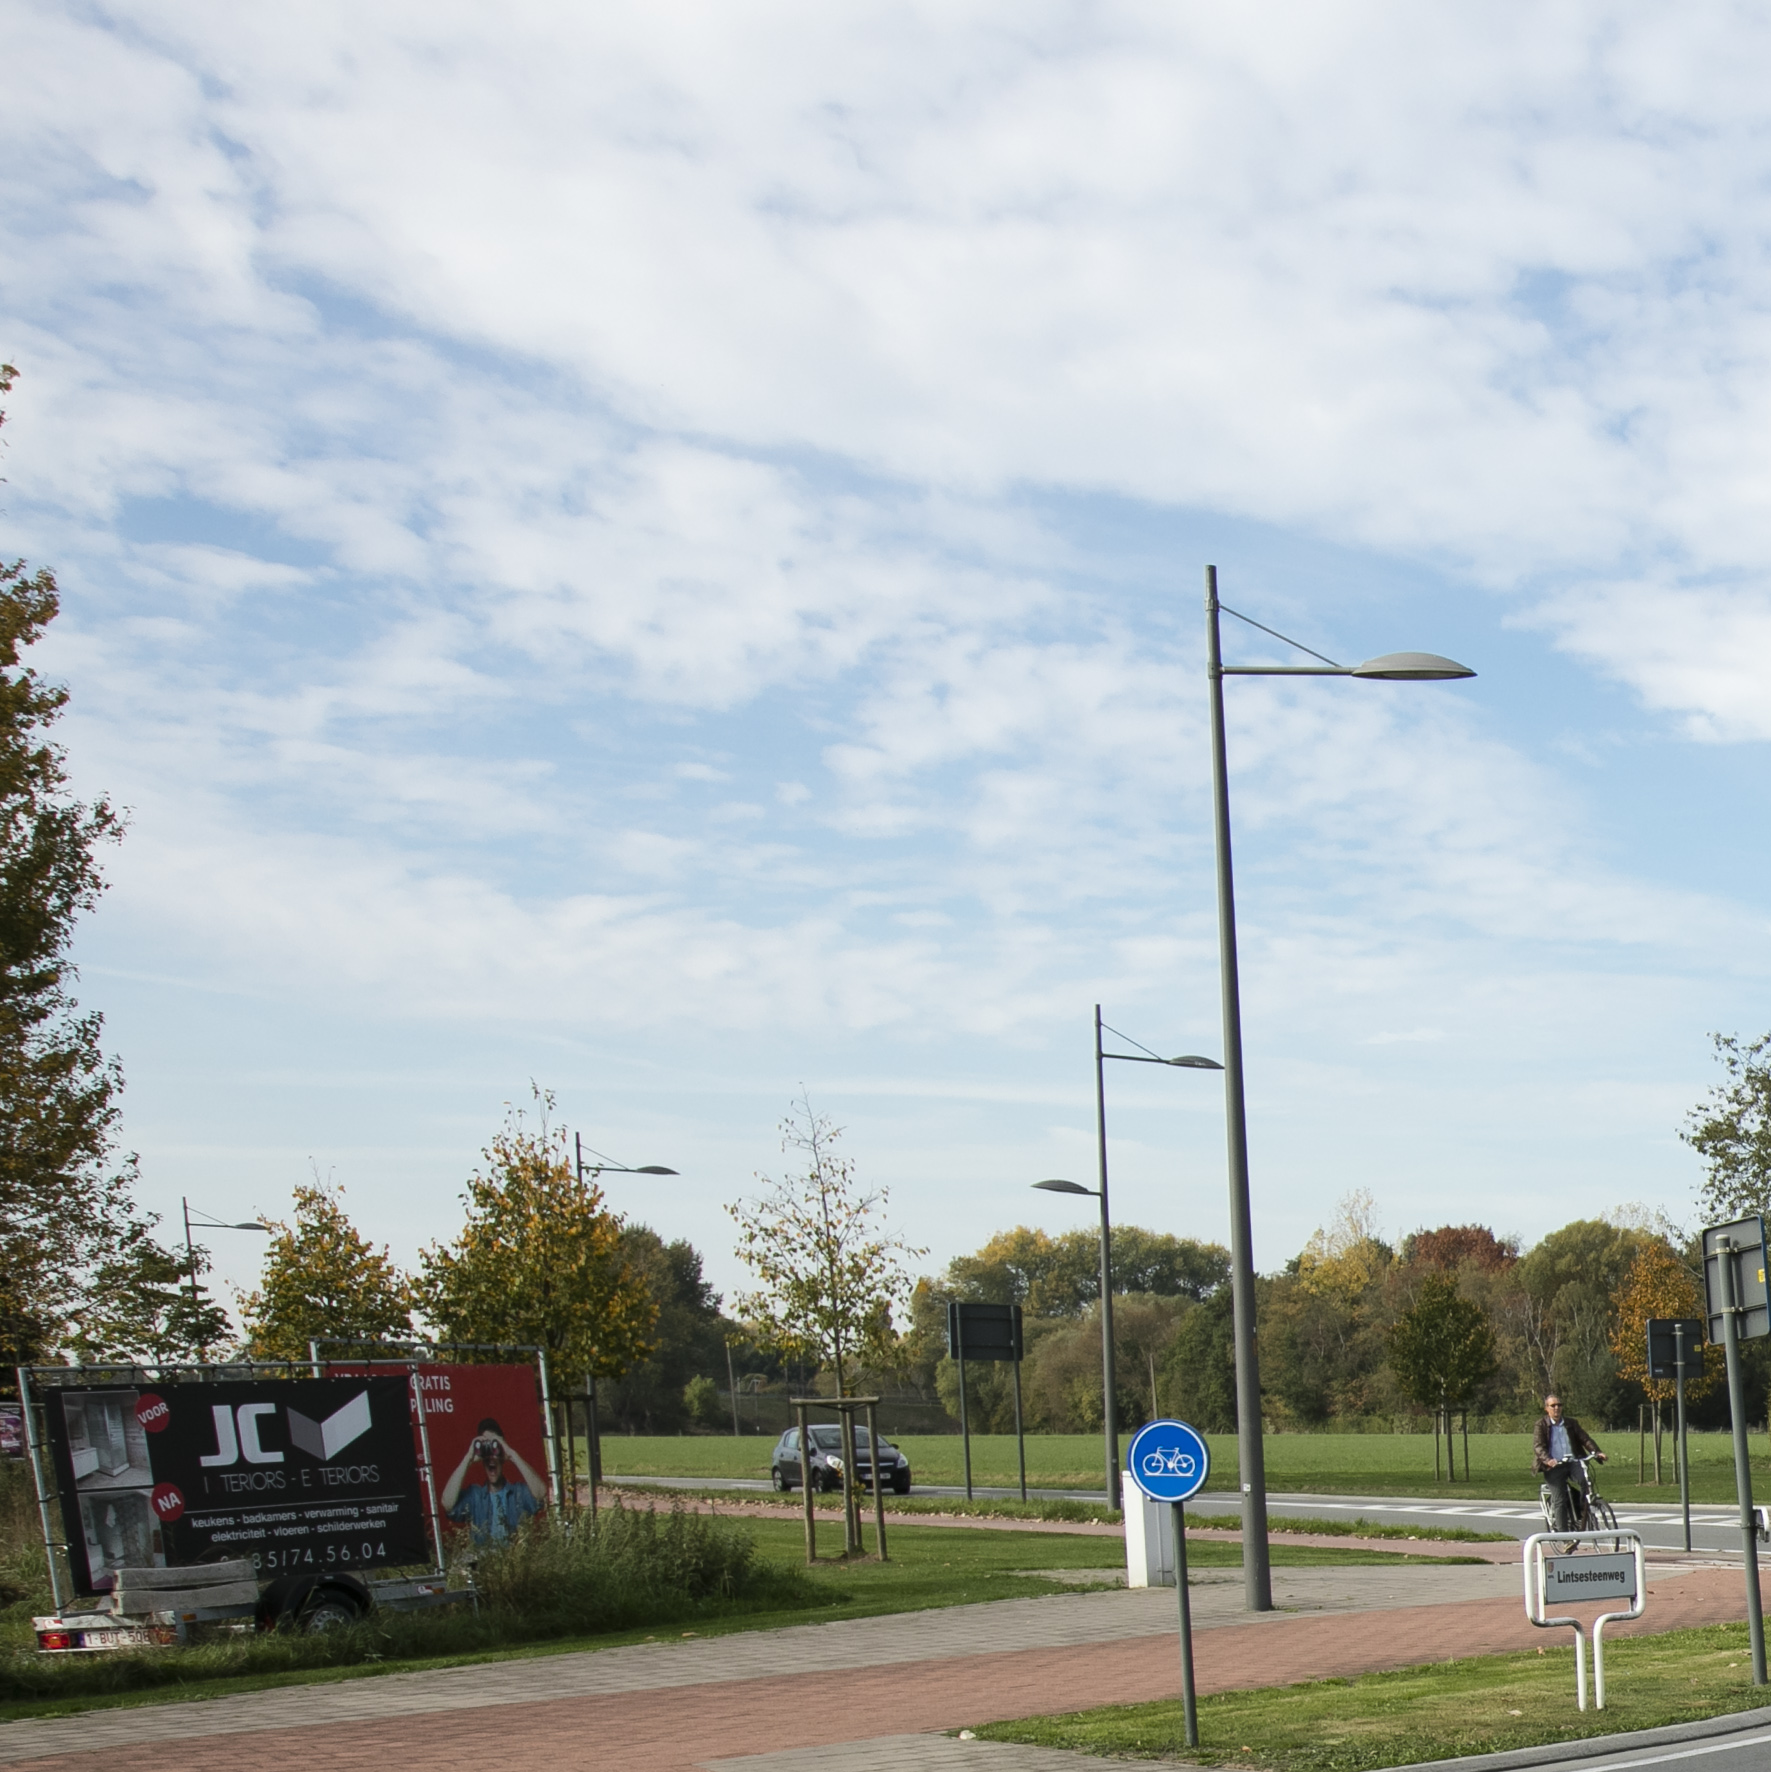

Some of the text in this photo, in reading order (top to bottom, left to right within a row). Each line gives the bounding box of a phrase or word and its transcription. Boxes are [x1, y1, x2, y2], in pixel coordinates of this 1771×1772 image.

[137, 1402, 170, 1424] VOOR
[199, 1403, 285, 1467] JC
[158, 1492, 182, 1512] NA
[191, 1516, 235, 1529] keukens
[242, 1508, 298, 1525] badkamers
[304, 1504, 360, 1519] verwarming
[366, 1503, 399, 1515] sanitair
[211, 1528, 267, 1543] elektriciteit
[274, 1526, 310, 1537] vloeren
[317, 1519, 387, 1533] schilderwerken
[1557, 1570, 1625, 1584] Lintsesteenweg
